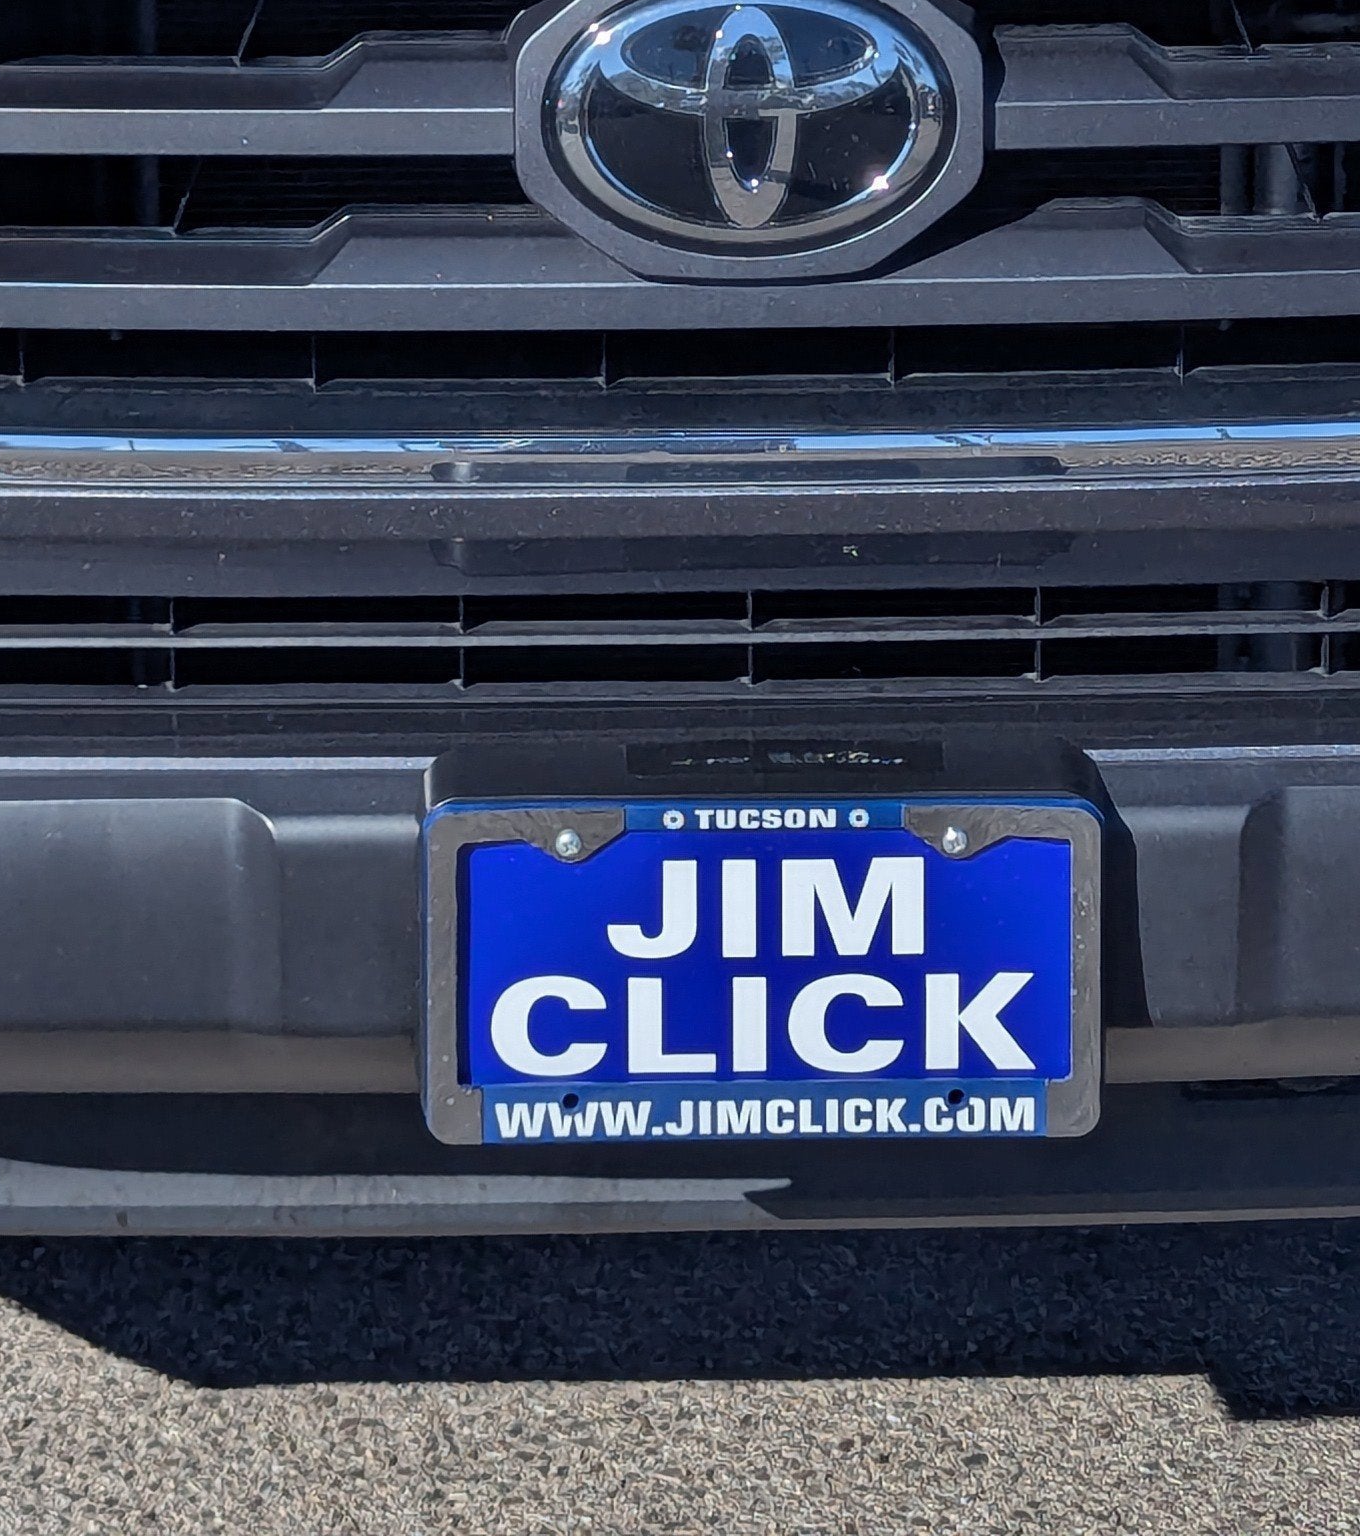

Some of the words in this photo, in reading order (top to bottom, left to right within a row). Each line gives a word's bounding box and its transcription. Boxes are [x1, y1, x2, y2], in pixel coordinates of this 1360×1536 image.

[694, 808, 837, 830] TUCSON
[607, 855, 926, 959] JIM
[489, 971, 1037, 1077] CLICK
[495, 1095, 1037, 1139] WWW.JIMCLICK.COM
